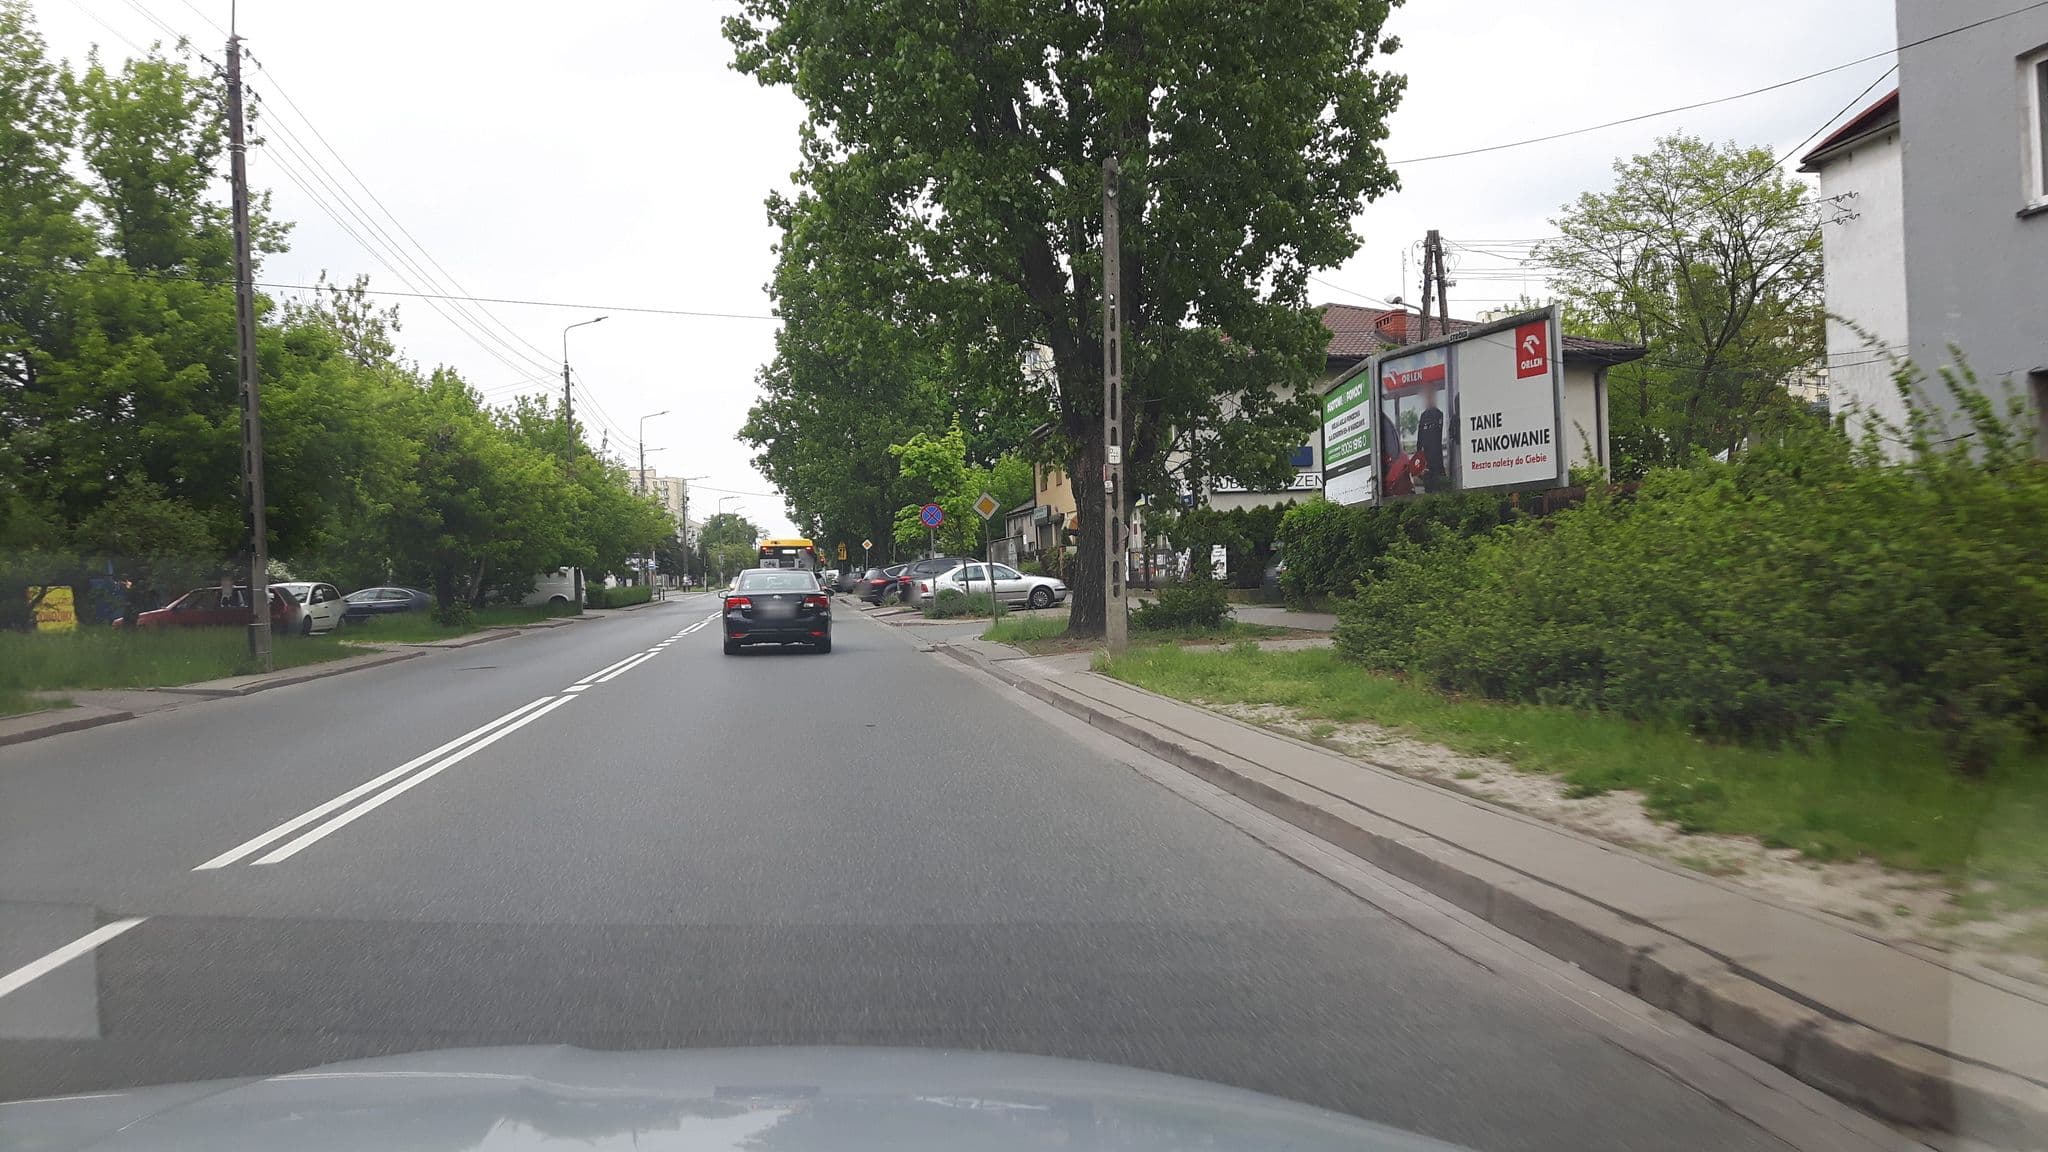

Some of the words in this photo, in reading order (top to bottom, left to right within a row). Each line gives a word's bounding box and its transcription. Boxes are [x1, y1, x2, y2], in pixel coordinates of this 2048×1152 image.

[1521, 358, 1542, 370] ORLEN
[1402, 370, 1423, 383] ORLEN
[1470, 412, 1502, 431] TANIE
[1471, 429, 1550, 453] TANKOWANIE
[1471, 459, 1492, 470] Reszta
[1493, 456, 1514, 470] należy
[1515, 456, 1524, 465] do
[1525, 453, 1547, 464] Ciebie
